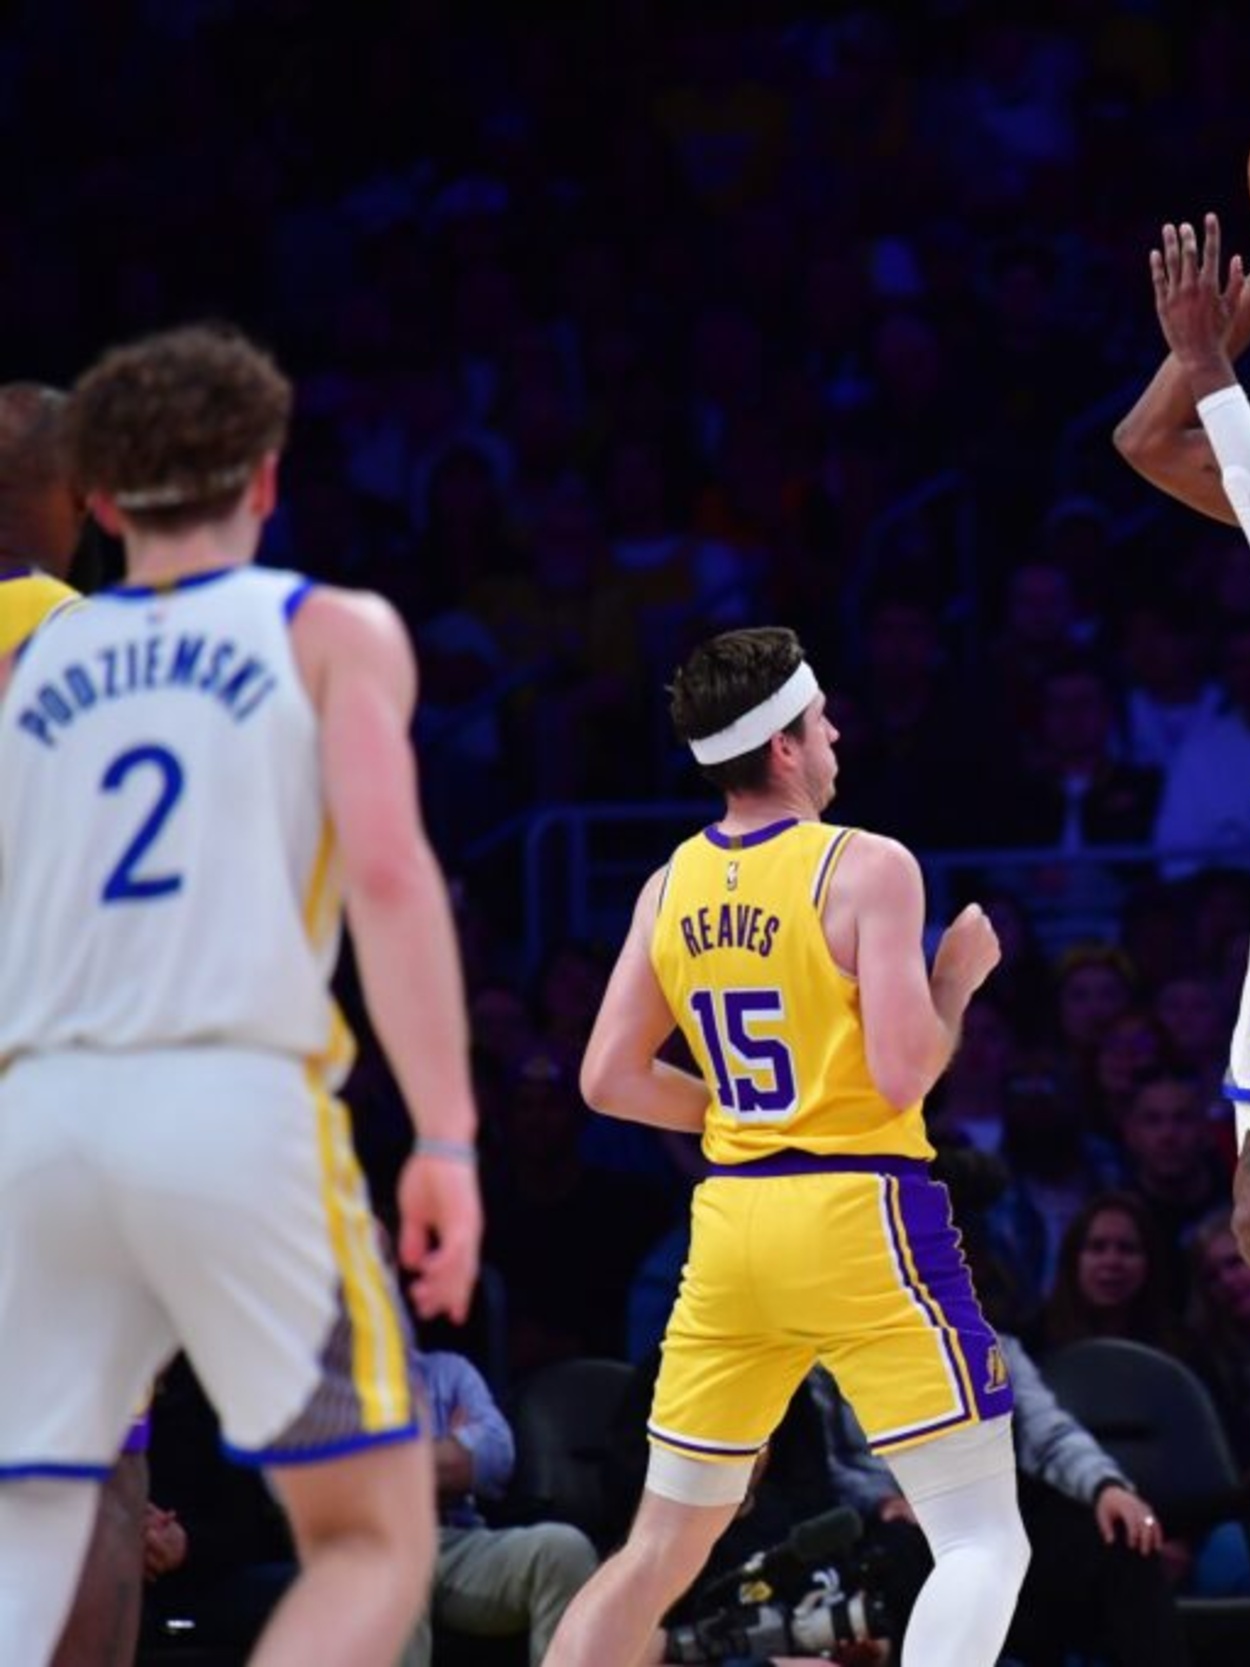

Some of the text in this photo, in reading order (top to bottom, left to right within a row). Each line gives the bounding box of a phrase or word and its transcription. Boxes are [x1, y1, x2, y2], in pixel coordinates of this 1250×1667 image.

[18, 634, 275, 748] PODZIEMSKI
[102, 744, 184, 903] 2
[680, 904, 780, 957] REAVES
[690, 989, 798, 1120] 15
